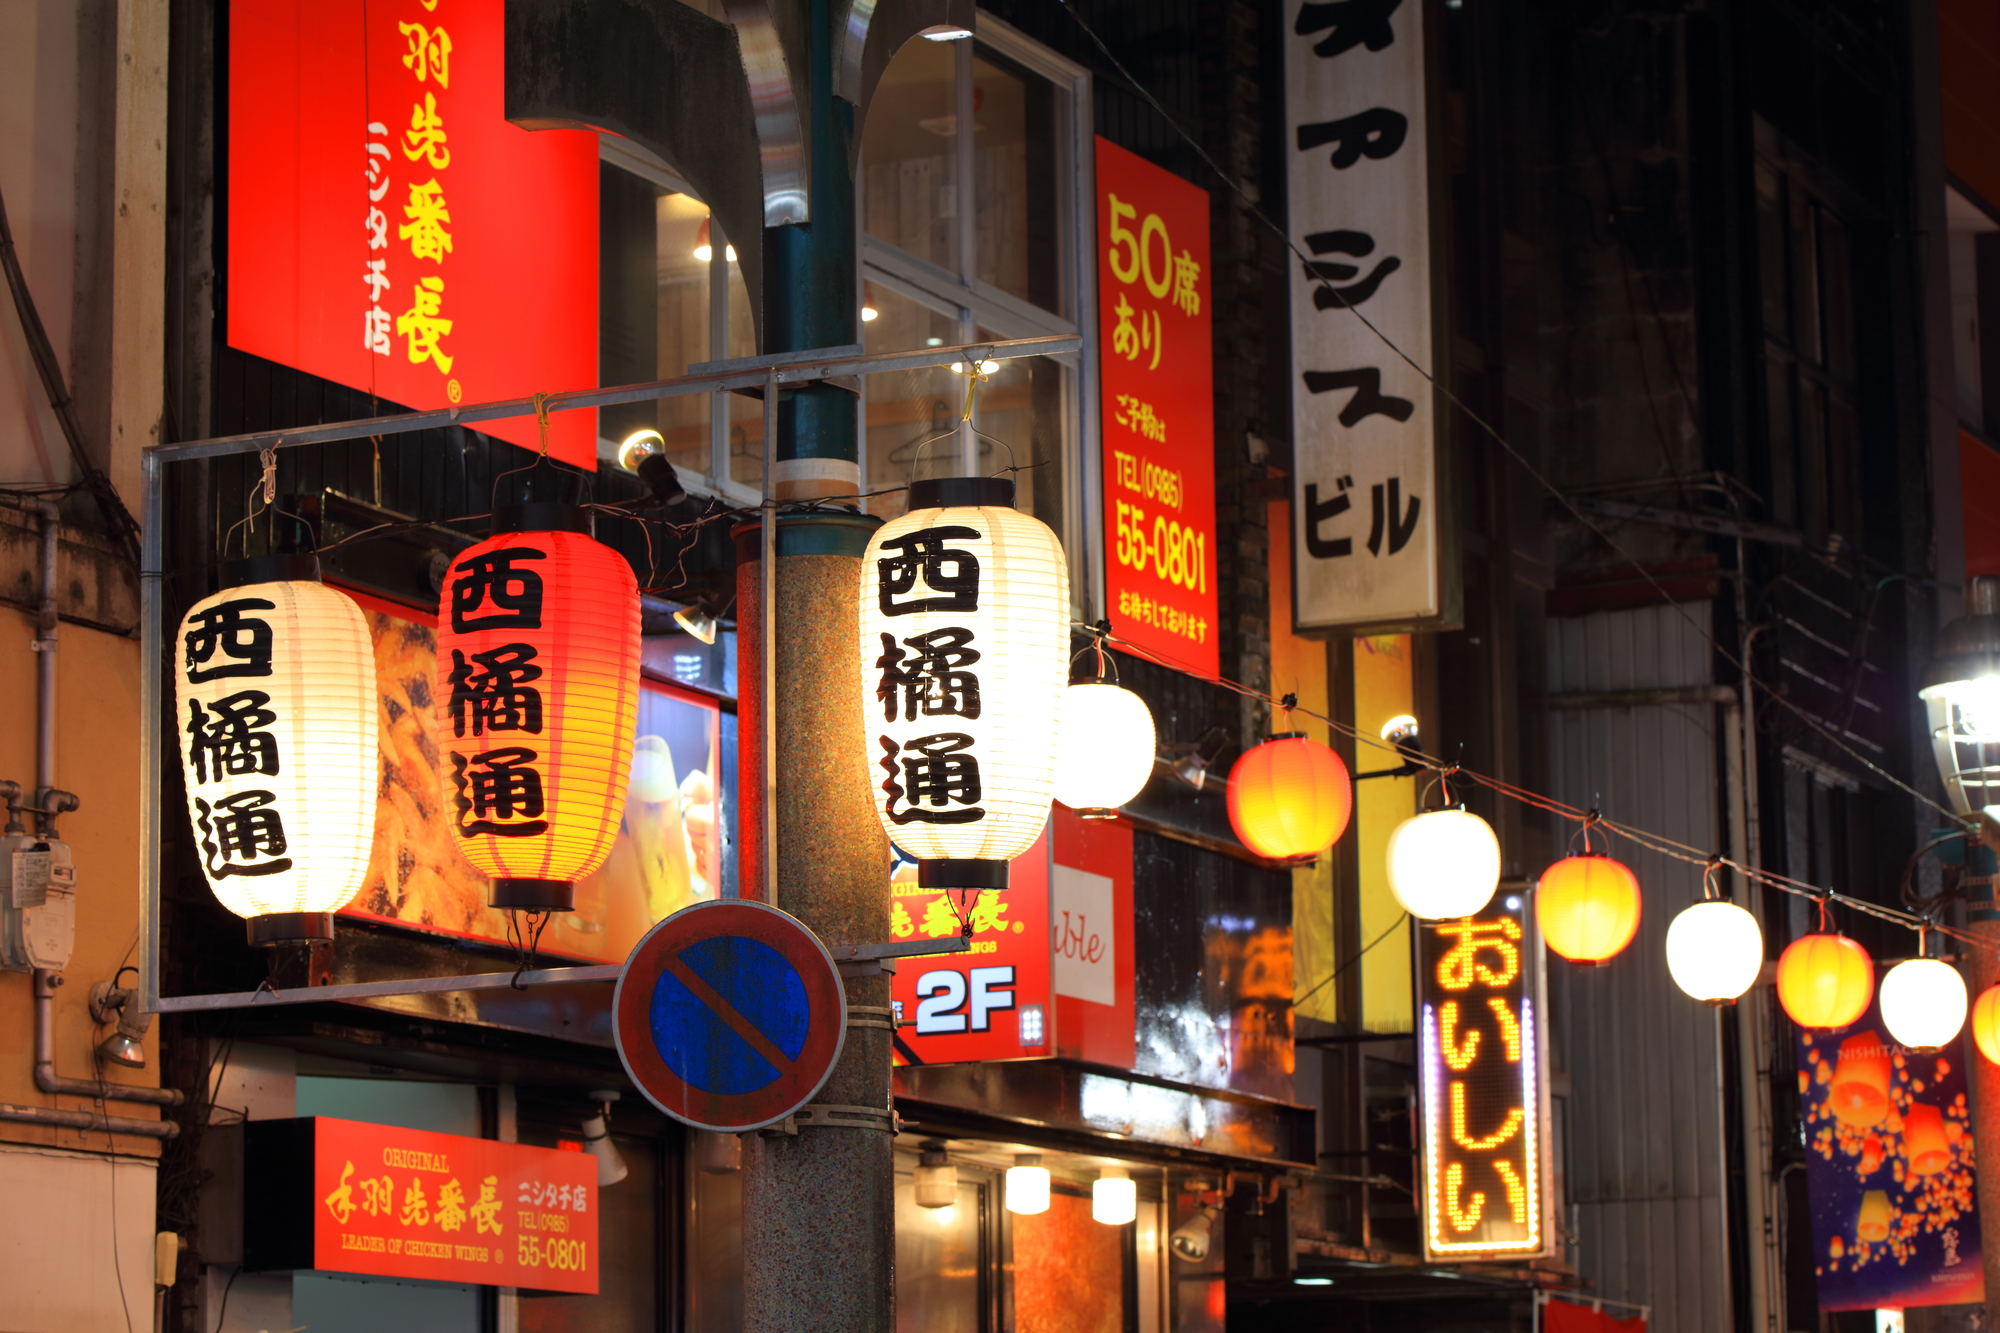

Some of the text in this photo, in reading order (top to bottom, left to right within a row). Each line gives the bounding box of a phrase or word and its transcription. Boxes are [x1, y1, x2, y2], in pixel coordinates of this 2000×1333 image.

[395, 0, 454, 376] 羽先番長
[363, 122, 391, 357] ニシタチ店
[1108, 193, 1201, 319] 50席
[1113, 291, 1162, 371] あり
[1114, 393, 1167, 444] ご予約は
[1116, 499, 1206, 595] 55-0801
[1119, 588, 1208, 645] お待ちしております
[447, 546, 549, 838] 西橘通
[876, 525, 985, 825] 西橘通
[186, 598, 292, 881] 西橘通
[916, 966, 1015, 1037] 2F
[1436, 916, 1525, 1232] おいしい
[325, 1160, 503, 1236] 手羽先番長
[383, 1147, 449, 1173] ORIGINAL
[518, 1181, 587, 1212] ニシタチ店
[341, 1233, 489, 1263] LEADER OF CHICKEN WINGS
[518, 1234, 586, 1272] 55-0801
